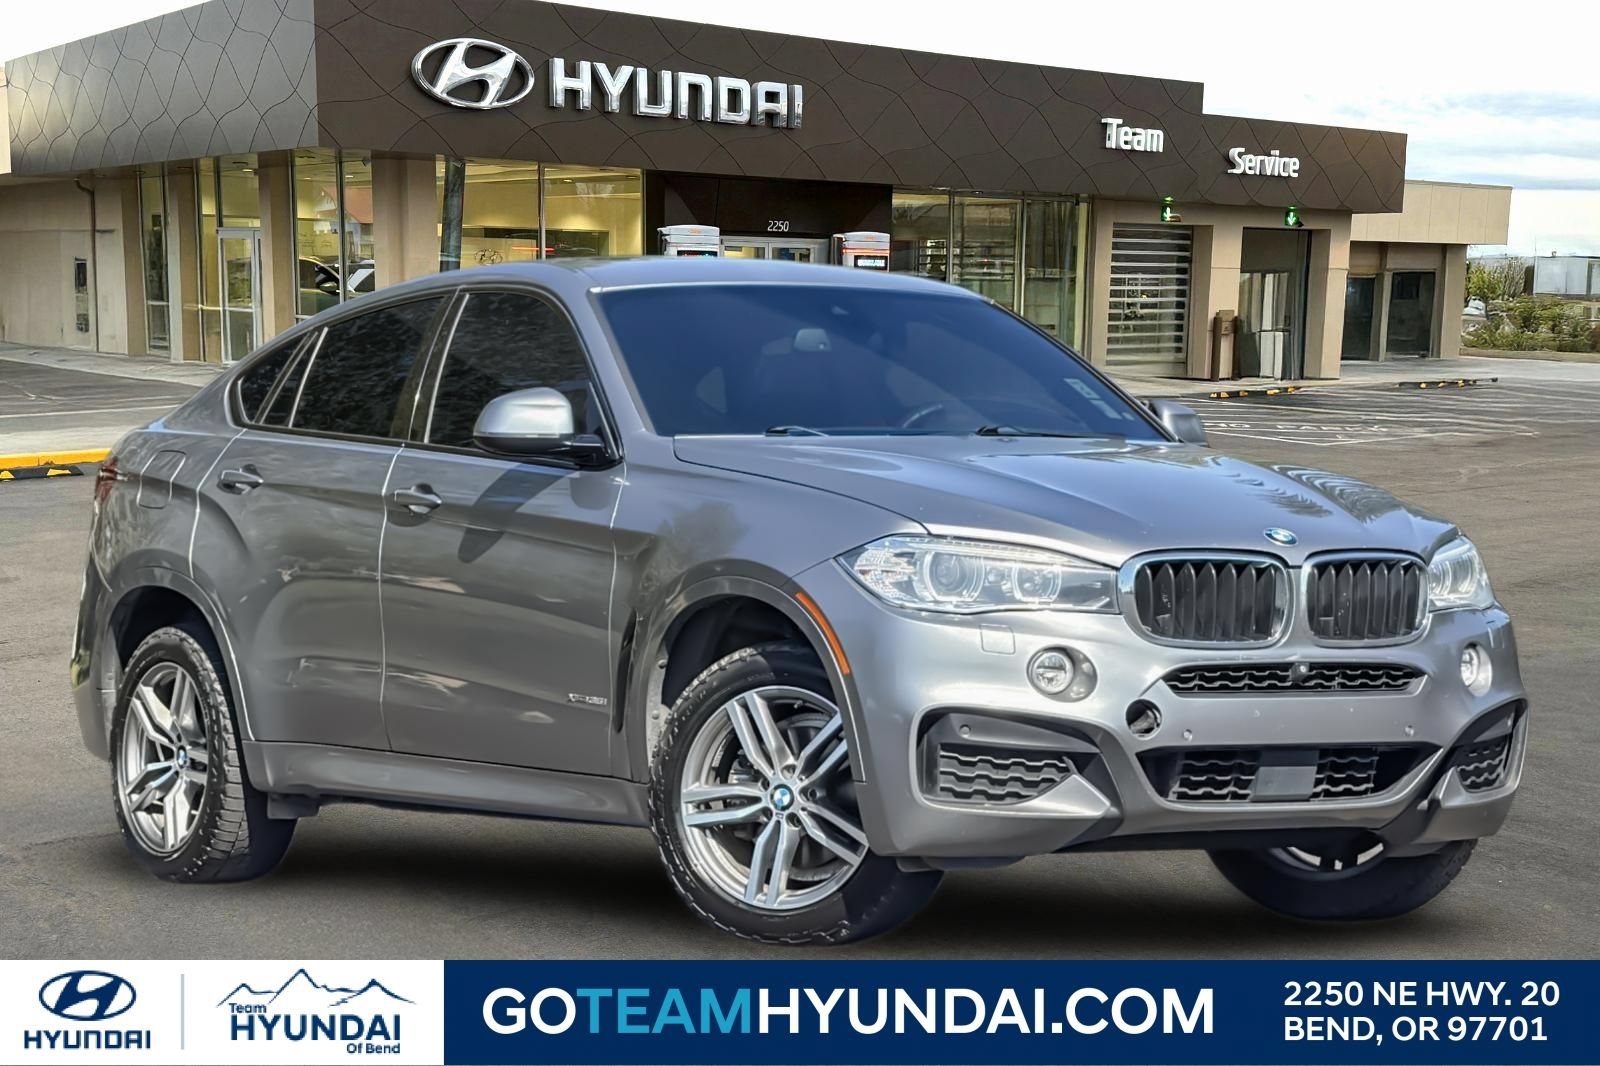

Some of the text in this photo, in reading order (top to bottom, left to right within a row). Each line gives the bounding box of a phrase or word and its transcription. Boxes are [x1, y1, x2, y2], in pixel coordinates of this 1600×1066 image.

[549, 57, 804, 129] HYUNDAI
[1101, 117, 1164, 153] Team
[1227, 147, 1300, 178] Service
[767, 220, 790, 232] 2250
